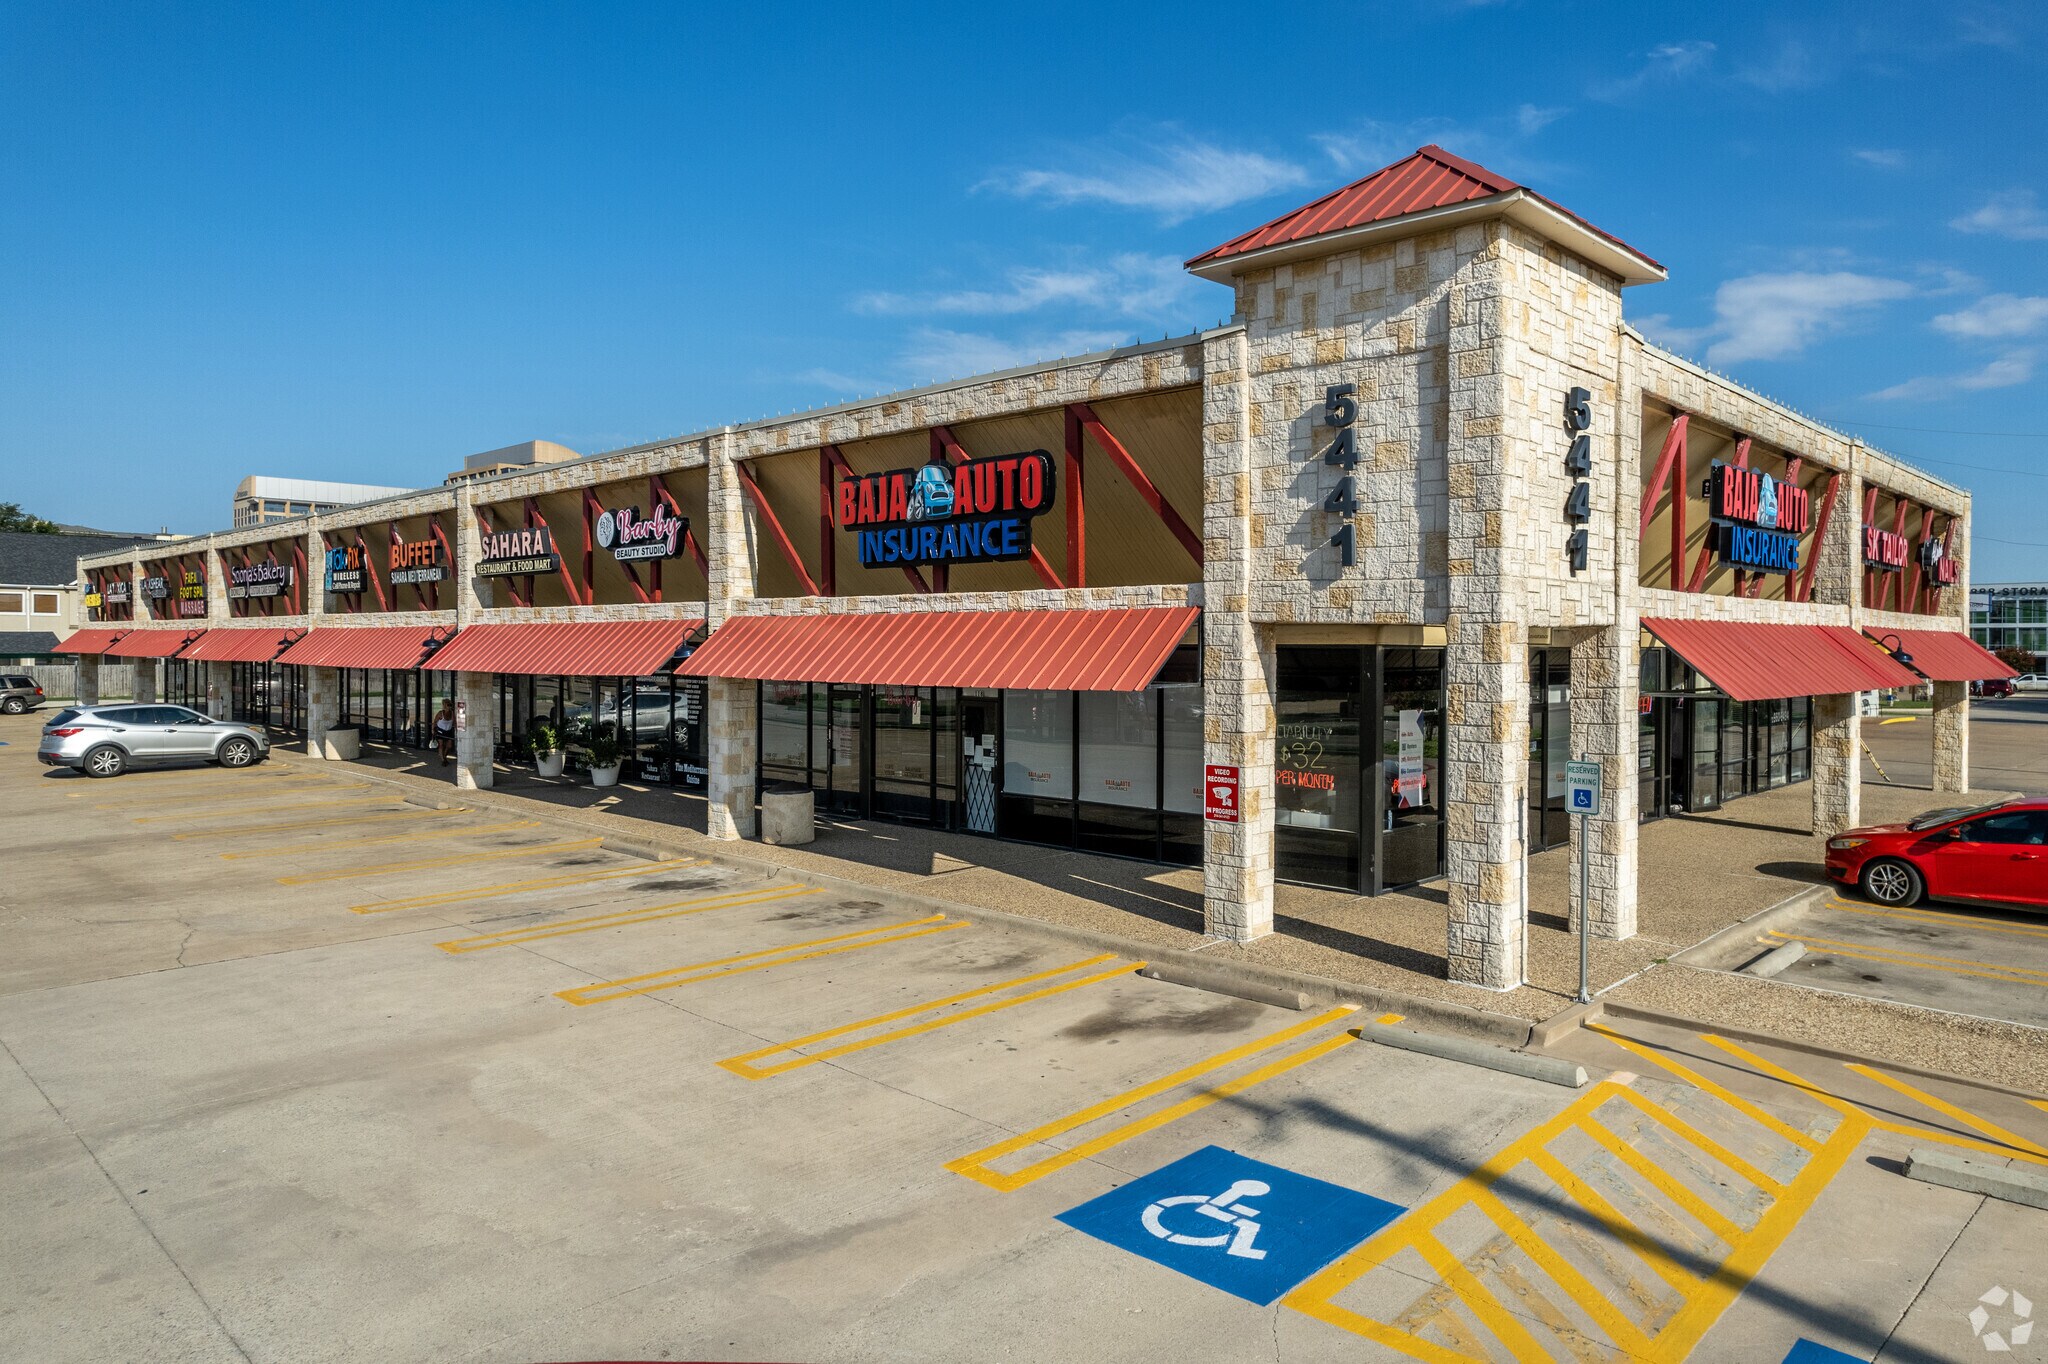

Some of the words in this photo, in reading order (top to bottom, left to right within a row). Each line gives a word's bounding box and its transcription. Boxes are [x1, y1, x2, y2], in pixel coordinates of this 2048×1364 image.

[1324, 383, 1360, 566] 5441
[1566, 386, 1592, 570] 5441
[840, 474, 906, 526] BAJA
[953, 455, 1043, 516] AUTO
[1723, 465, 1758, 522] BAJA
[1776, 482, 1808, 534] AUTO
[616, 503, 681, 555] Barby
[857, 518, 1021, 563] INSURANCE
[392, 539, 437, 570] BUFFET
[482, 529, 545, 560] SAHARA
[616, 548, 640, 559] BEAUTY
[641, 545, 665, 556] STUDIO
[1731, 526, 1800, 570] INSURANCE
[1867, 527, 1879, 561] SK
[1882, 532, 1908, 568] TAILOR
[258, 558, 285, 586] Bakery
[333, 571, 360, 581] WIRELESS
[476, 562, 511, 574] RESTAURANT
[517, 560, 533, 571] FOOD
[534, 558, 551, 569] MART
[1938, 557, 1959, 584] NAILS
[180, 600, 204, 615] MASSAGE
[1207, 775, 1237, 785] RECORDING
[1214, 768, 1230, 776] VIDEO
[1275, 769, 1296, 785] PER
[1298, 771, 1335, 790] MONTH
[1568, 765, 1598, 775] RESERVED
[1569, 776, 1597, 786] PARKING
[1212, 807, 1238, 817] PROGRESS
